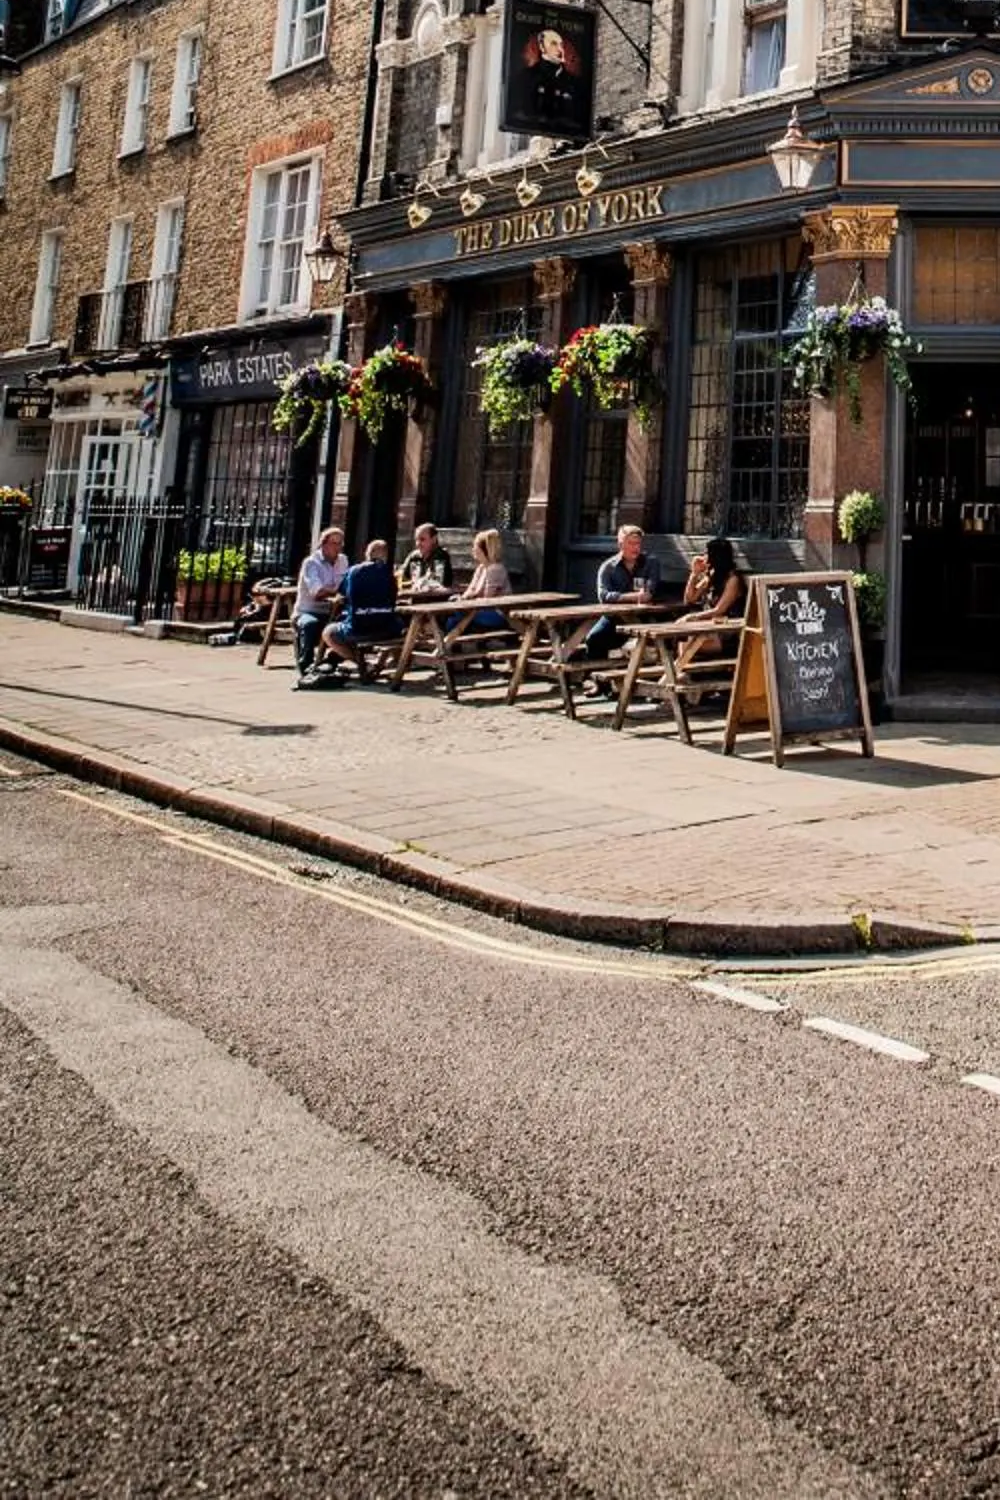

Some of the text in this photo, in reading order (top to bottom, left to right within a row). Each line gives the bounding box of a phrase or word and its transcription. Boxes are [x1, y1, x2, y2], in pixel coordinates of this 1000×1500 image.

[454, 184, 664, 255] THE DUKE OF YORK
[200, 359, 234, 388] PARK
[236, 351, 293, 384] ESTATES
